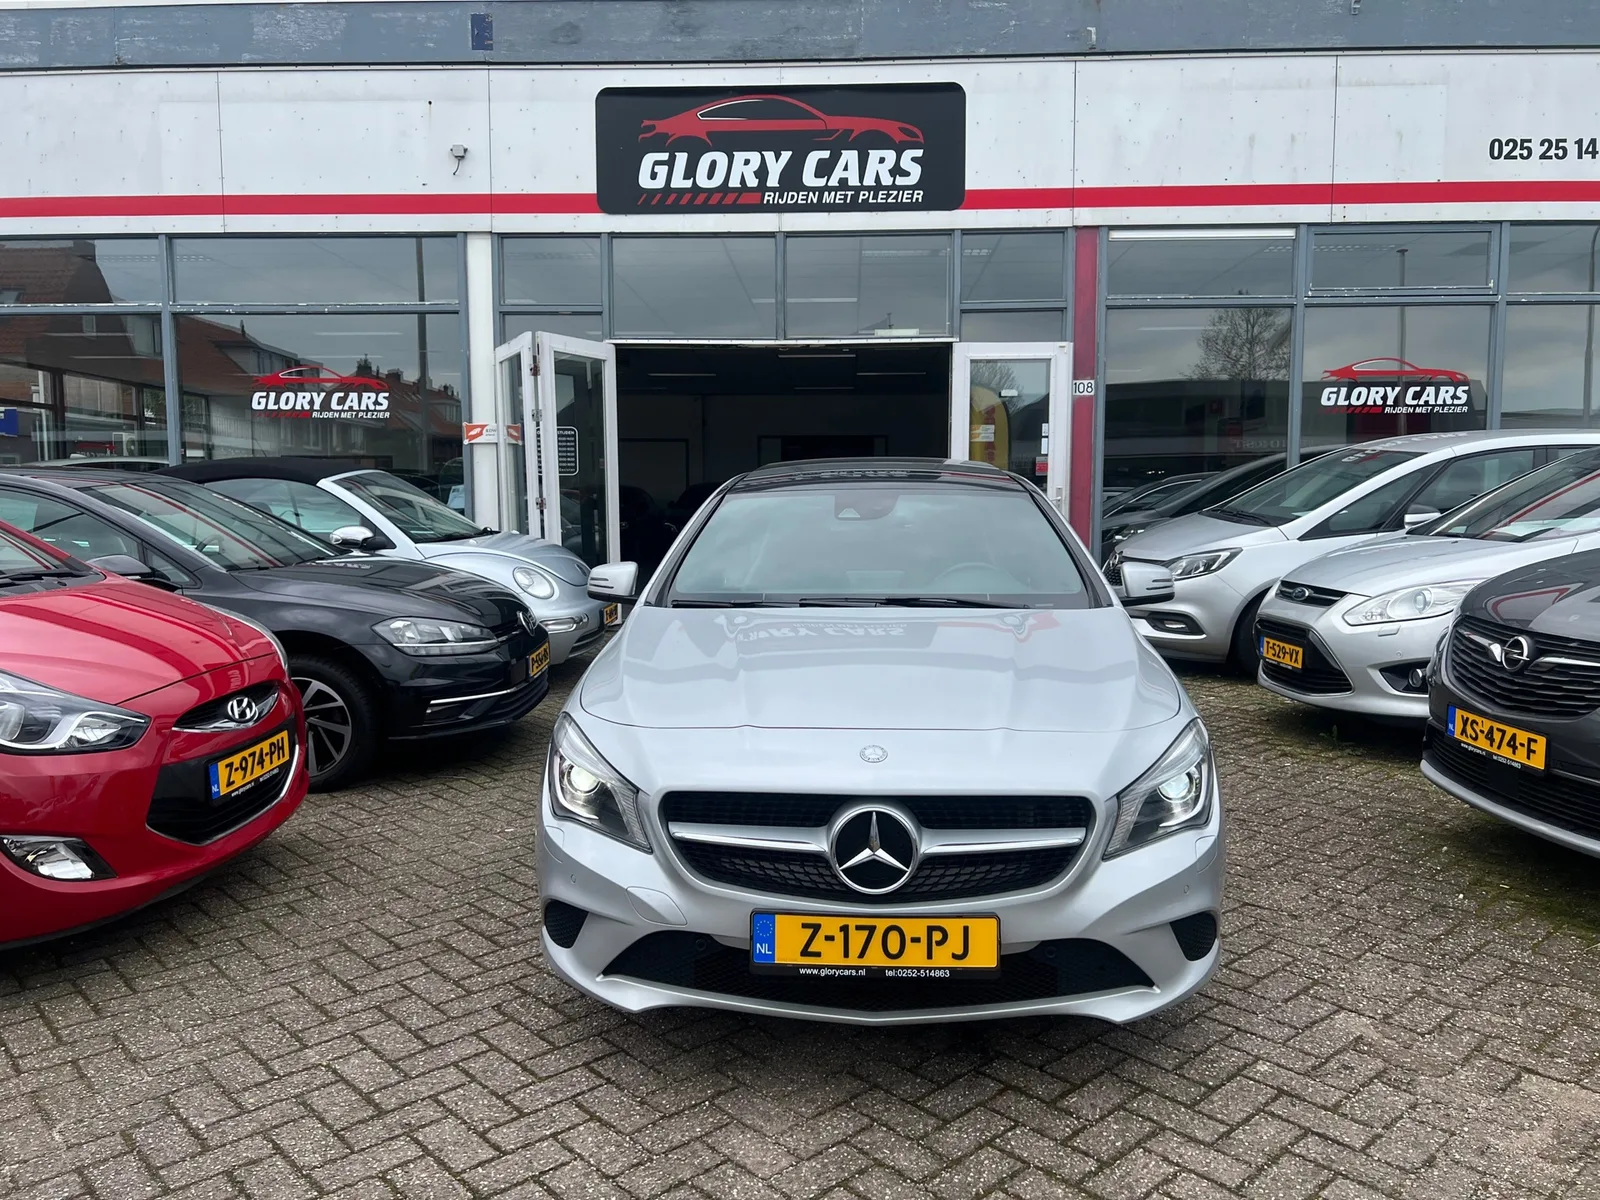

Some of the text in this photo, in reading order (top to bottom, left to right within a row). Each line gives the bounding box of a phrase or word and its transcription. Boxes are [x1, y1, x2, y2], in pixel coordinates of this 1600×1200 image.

[1489, 138, 1599, 160] 025 25 14
[638, 149, 924, 189] GLORY CARS
[763, 190, 924, 205] RIJDEN MET PLEZIER
[1073, 382, 1094, 394] 108
[1320, 385, 1470, 406] GLORY CARS
[251, 391, 390, 411] GLORY CARS
[312, 411, 390, 419] RIJDEN MET PLEZIER
[1265, 640, 1300, 665] T-529-VX
[1460, 714, 1538, 761] XS-474-F
[224, 736, 286, 788] Z-974-PH
[211, 784, 220, 793] NL
[756, 943, 772, 955] NL
[799, 922, 970, 961] Z-170-PJ
[799, 967, 950, 978] www.glorycars.nl tel:0252-514863
